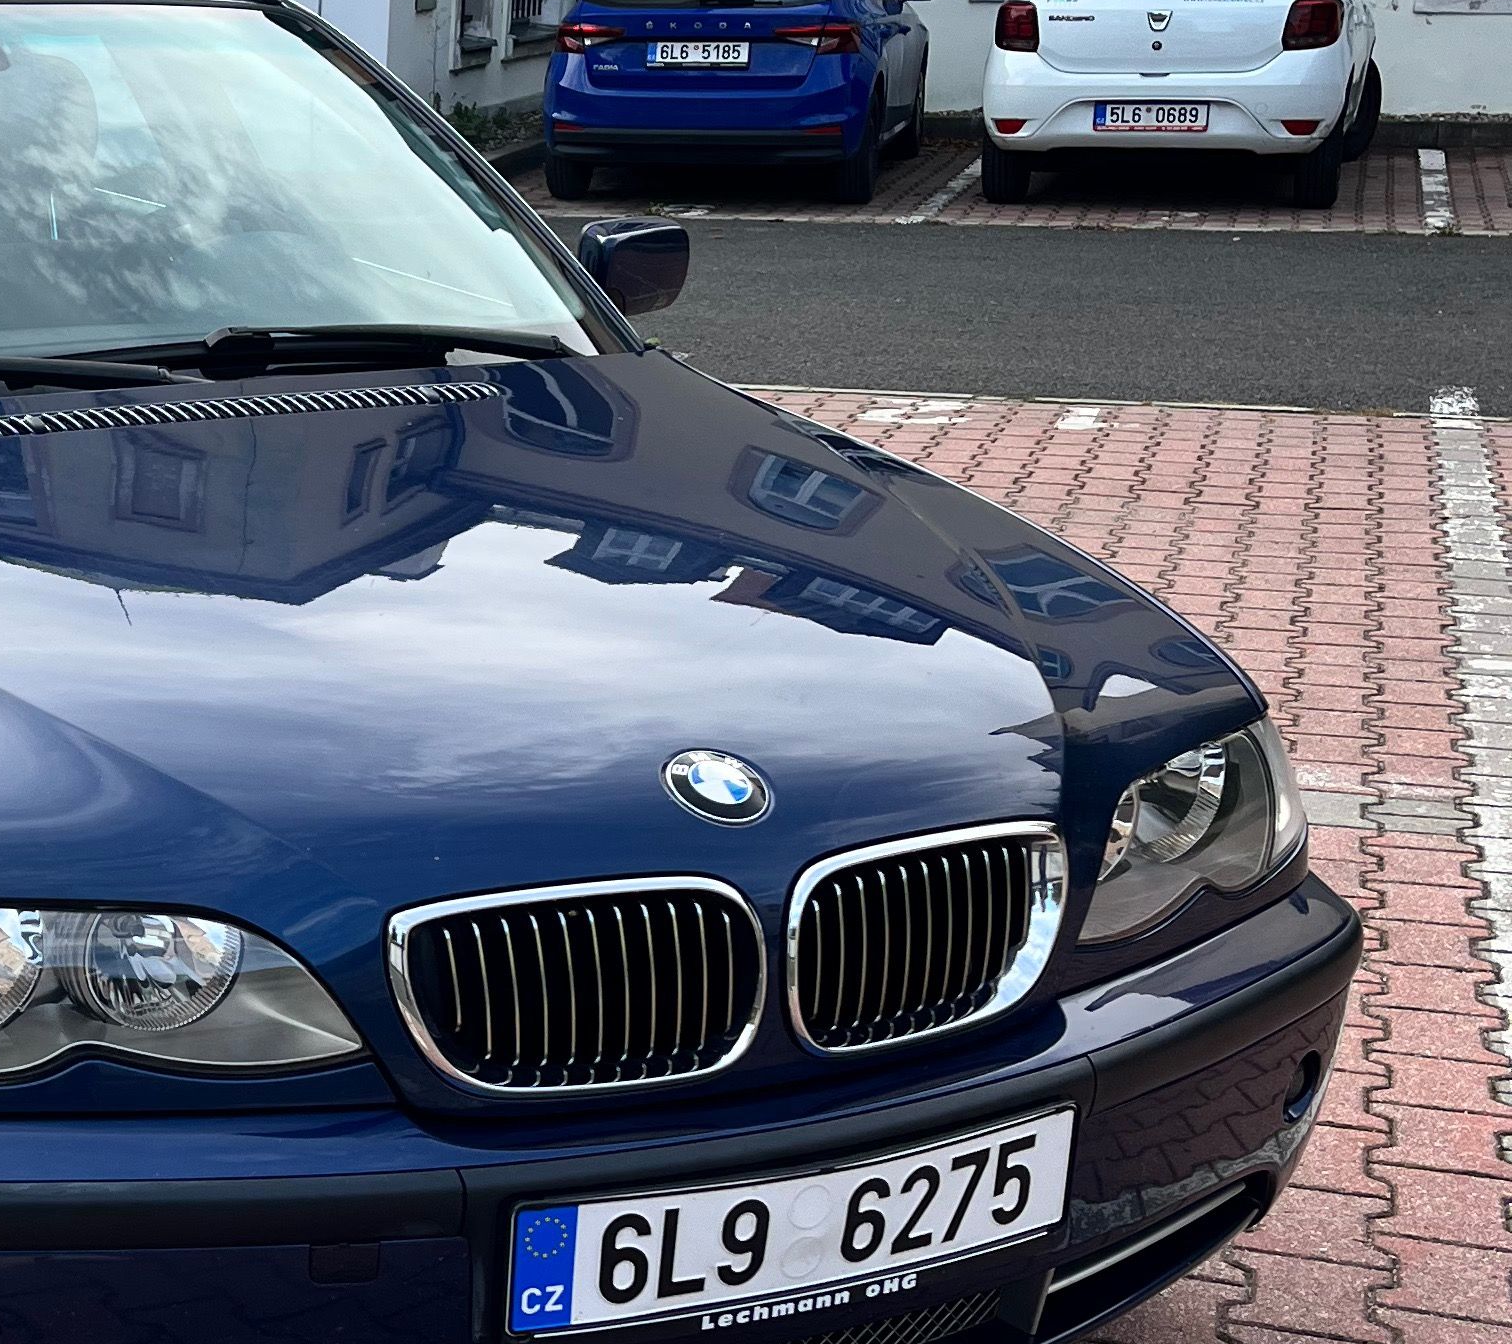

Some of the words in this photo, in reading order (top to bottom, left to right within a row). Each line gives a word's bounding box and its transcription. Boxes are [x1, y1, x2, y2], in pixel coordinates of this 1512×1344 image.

[660, 44, 690, 60] 6L6
[701, 44, 742, 60] 5185
[1109, 106, 1142, 124] 5L6
[1155, 106, 1199, 124] 0689
[597, 1198, 770, 1305] 6L9
[838, 1133, 1037, 1264] 6275
[520, 1284, 565, 1316] CZ
[700, 1290, 851, 1331] Lechmann
